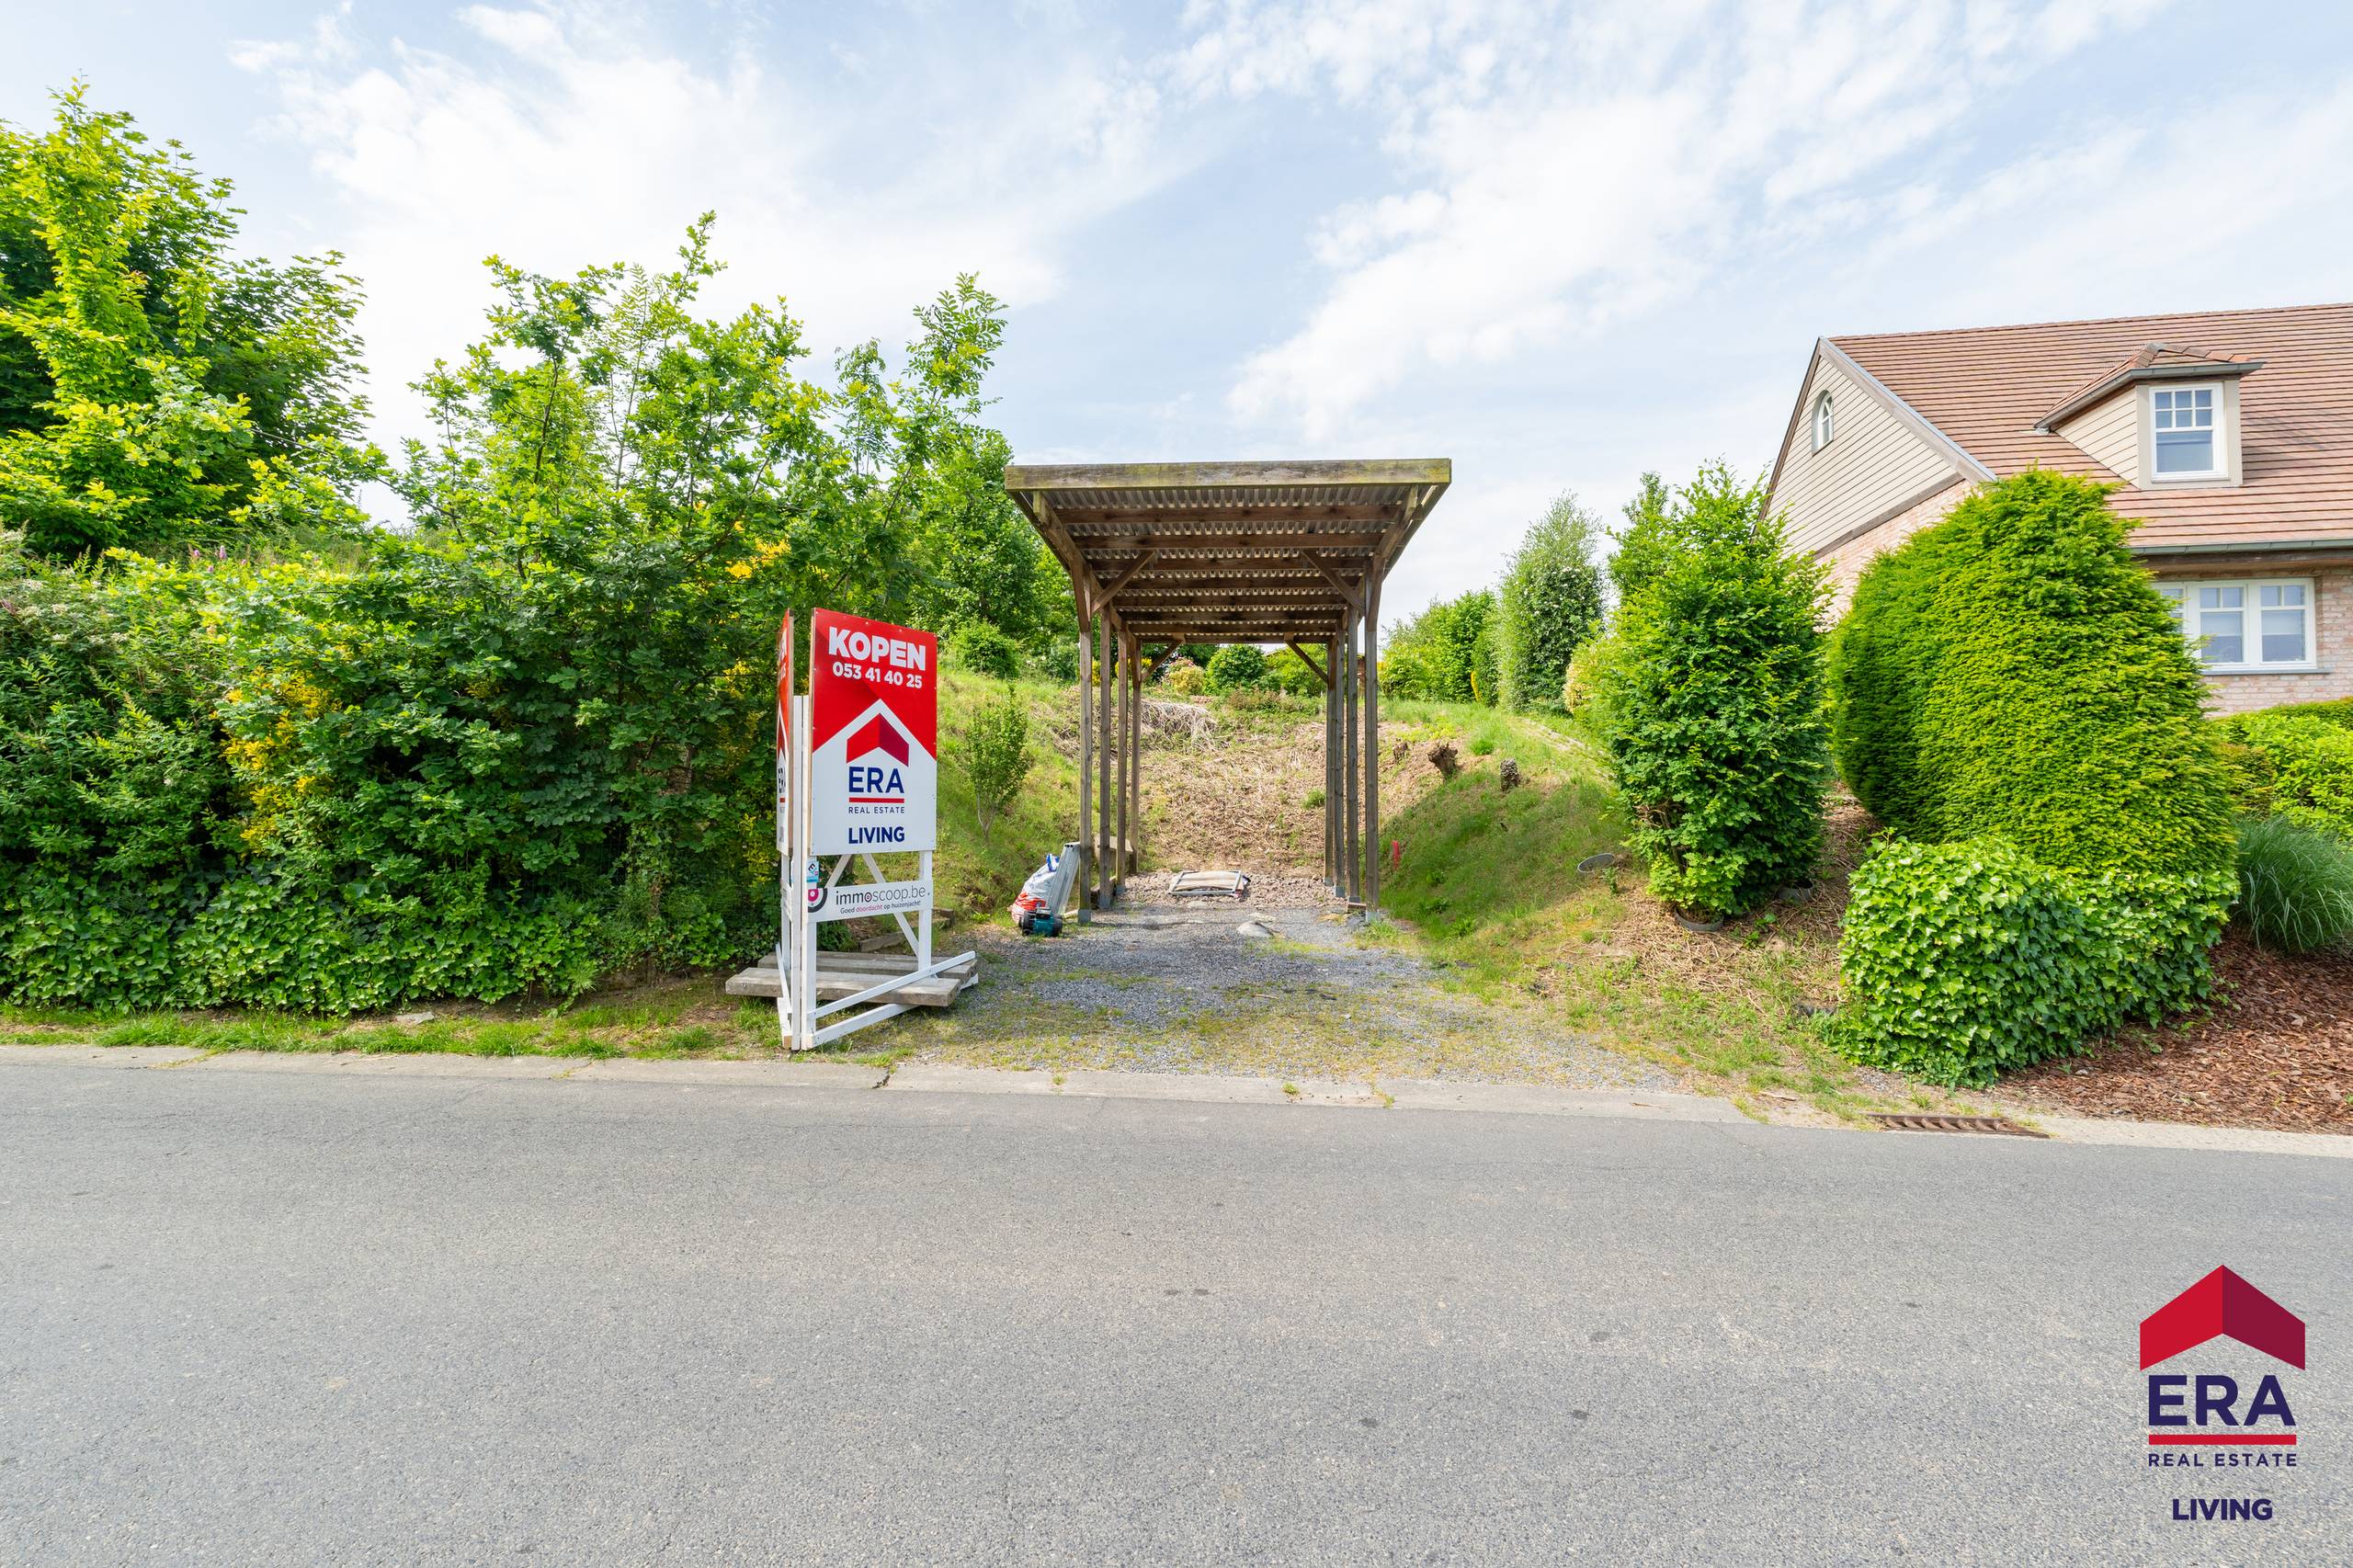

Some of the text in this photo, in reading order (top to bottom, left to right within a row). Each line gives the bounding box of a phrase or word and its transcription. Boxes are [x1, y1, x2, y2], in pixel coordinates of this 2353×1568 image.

[828, 627, 926, 671] KOPEN
[832, 662, 922, 688] 053 41 40 25
[848, 766, 904, 794] ERA
[848, 806, 905, 814] REAL ESTATE
[848, 825, 905, 845] LIVING
[835, 885, 926, 905] immoscoop.be
[856, 903, 882, 913] doordacht
